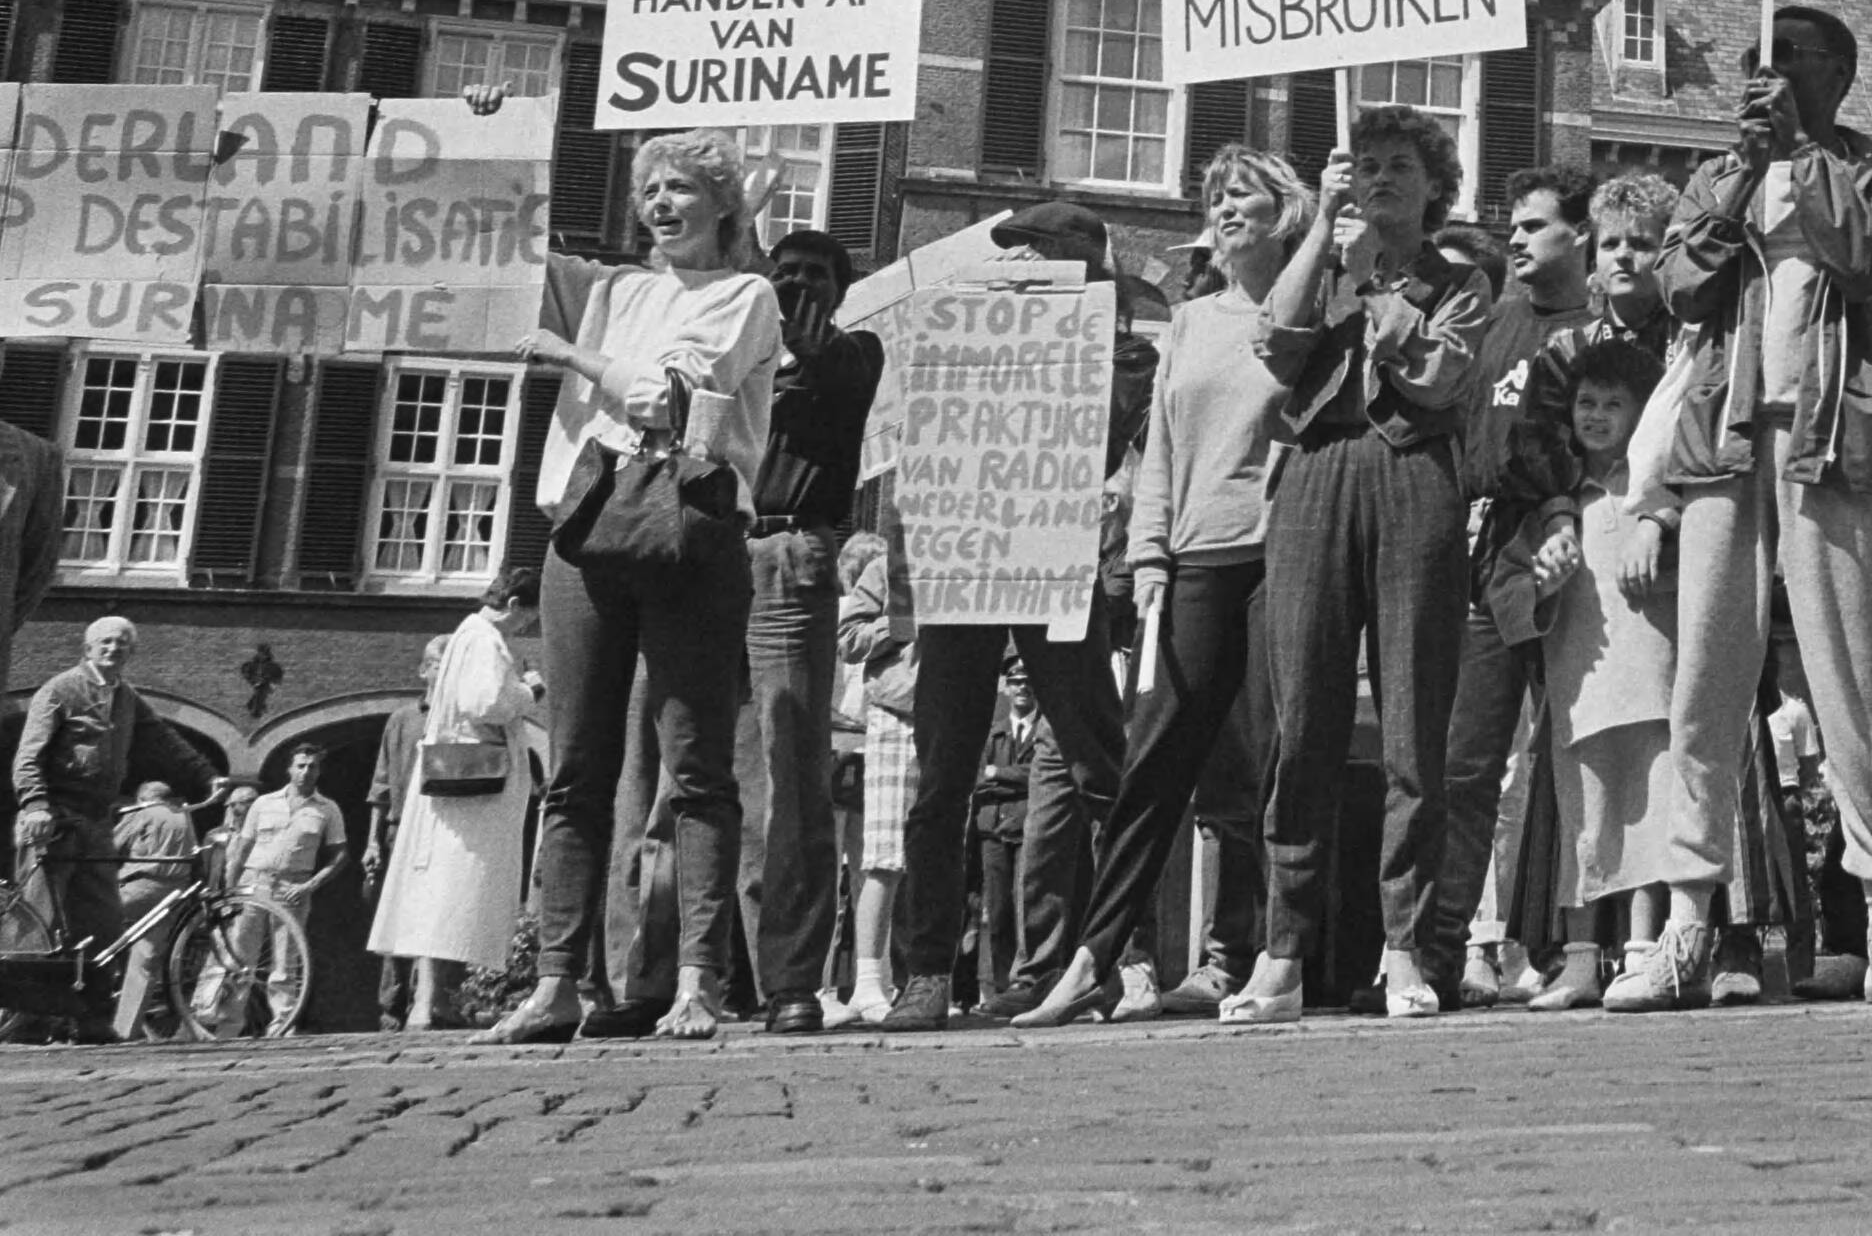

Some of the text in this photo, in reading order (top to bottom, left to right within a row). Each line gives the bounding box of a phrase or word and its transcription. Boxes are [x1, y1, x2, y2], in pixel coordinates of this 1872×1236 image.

[709, 17, 794, 50] VAN
[607, 49, 891, 113] SURINAME
[924, 296, 1049, 336] STOP
[899, 449, 1094, 492] VAN RADIO
[897, 490, 1102, 530] NEDERLAND
